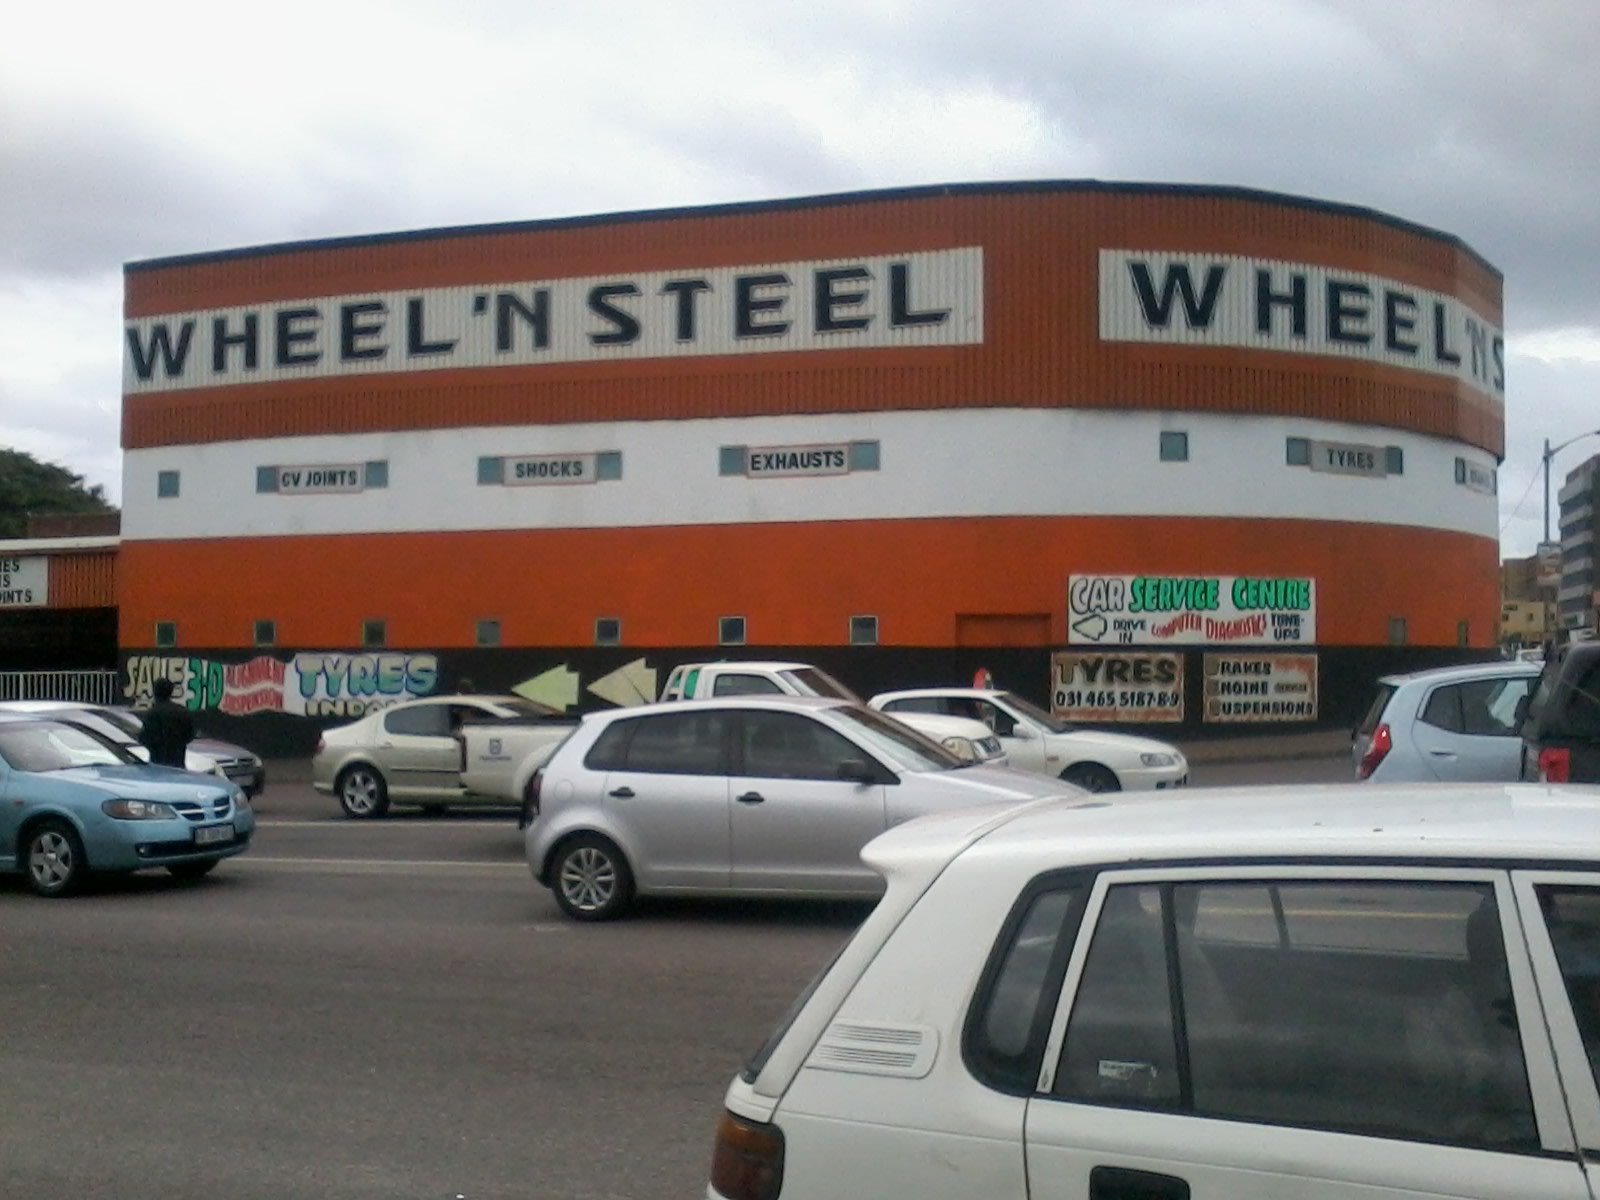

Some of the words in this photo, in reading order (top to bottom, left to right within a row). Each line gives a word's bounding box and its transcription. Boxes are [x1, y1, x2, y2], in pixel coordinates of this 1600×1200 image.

[587, 261, 952, 345] STEEL
[751, 451, 844, 471] EXHAUSTS
[1327, 448, 1375, 470] TYRES
[515, 461, 583, 478] SHOCKS
[282, 471, 301, 487] CV
[305, 470, 357, 487] JOINTS
[0, 559, 20, 572] ES
[1070, 578, 1125, 615] CAR
[1128, 577, 1219, 613] SERVICE
[1232, 577, 1311, 611] CENTRE
[1113, 620, 1147, 631] DRIVE
[1274, 628, 1301, 640] UPS
[1119, 632, 1133, 644] IN
[295, 655, 437, 697] TYRES
[1056, 658, 1177, 684] TYRES
[1056, 691, 1081, 706] 031
[1086, 691, 1115, 706] 465
